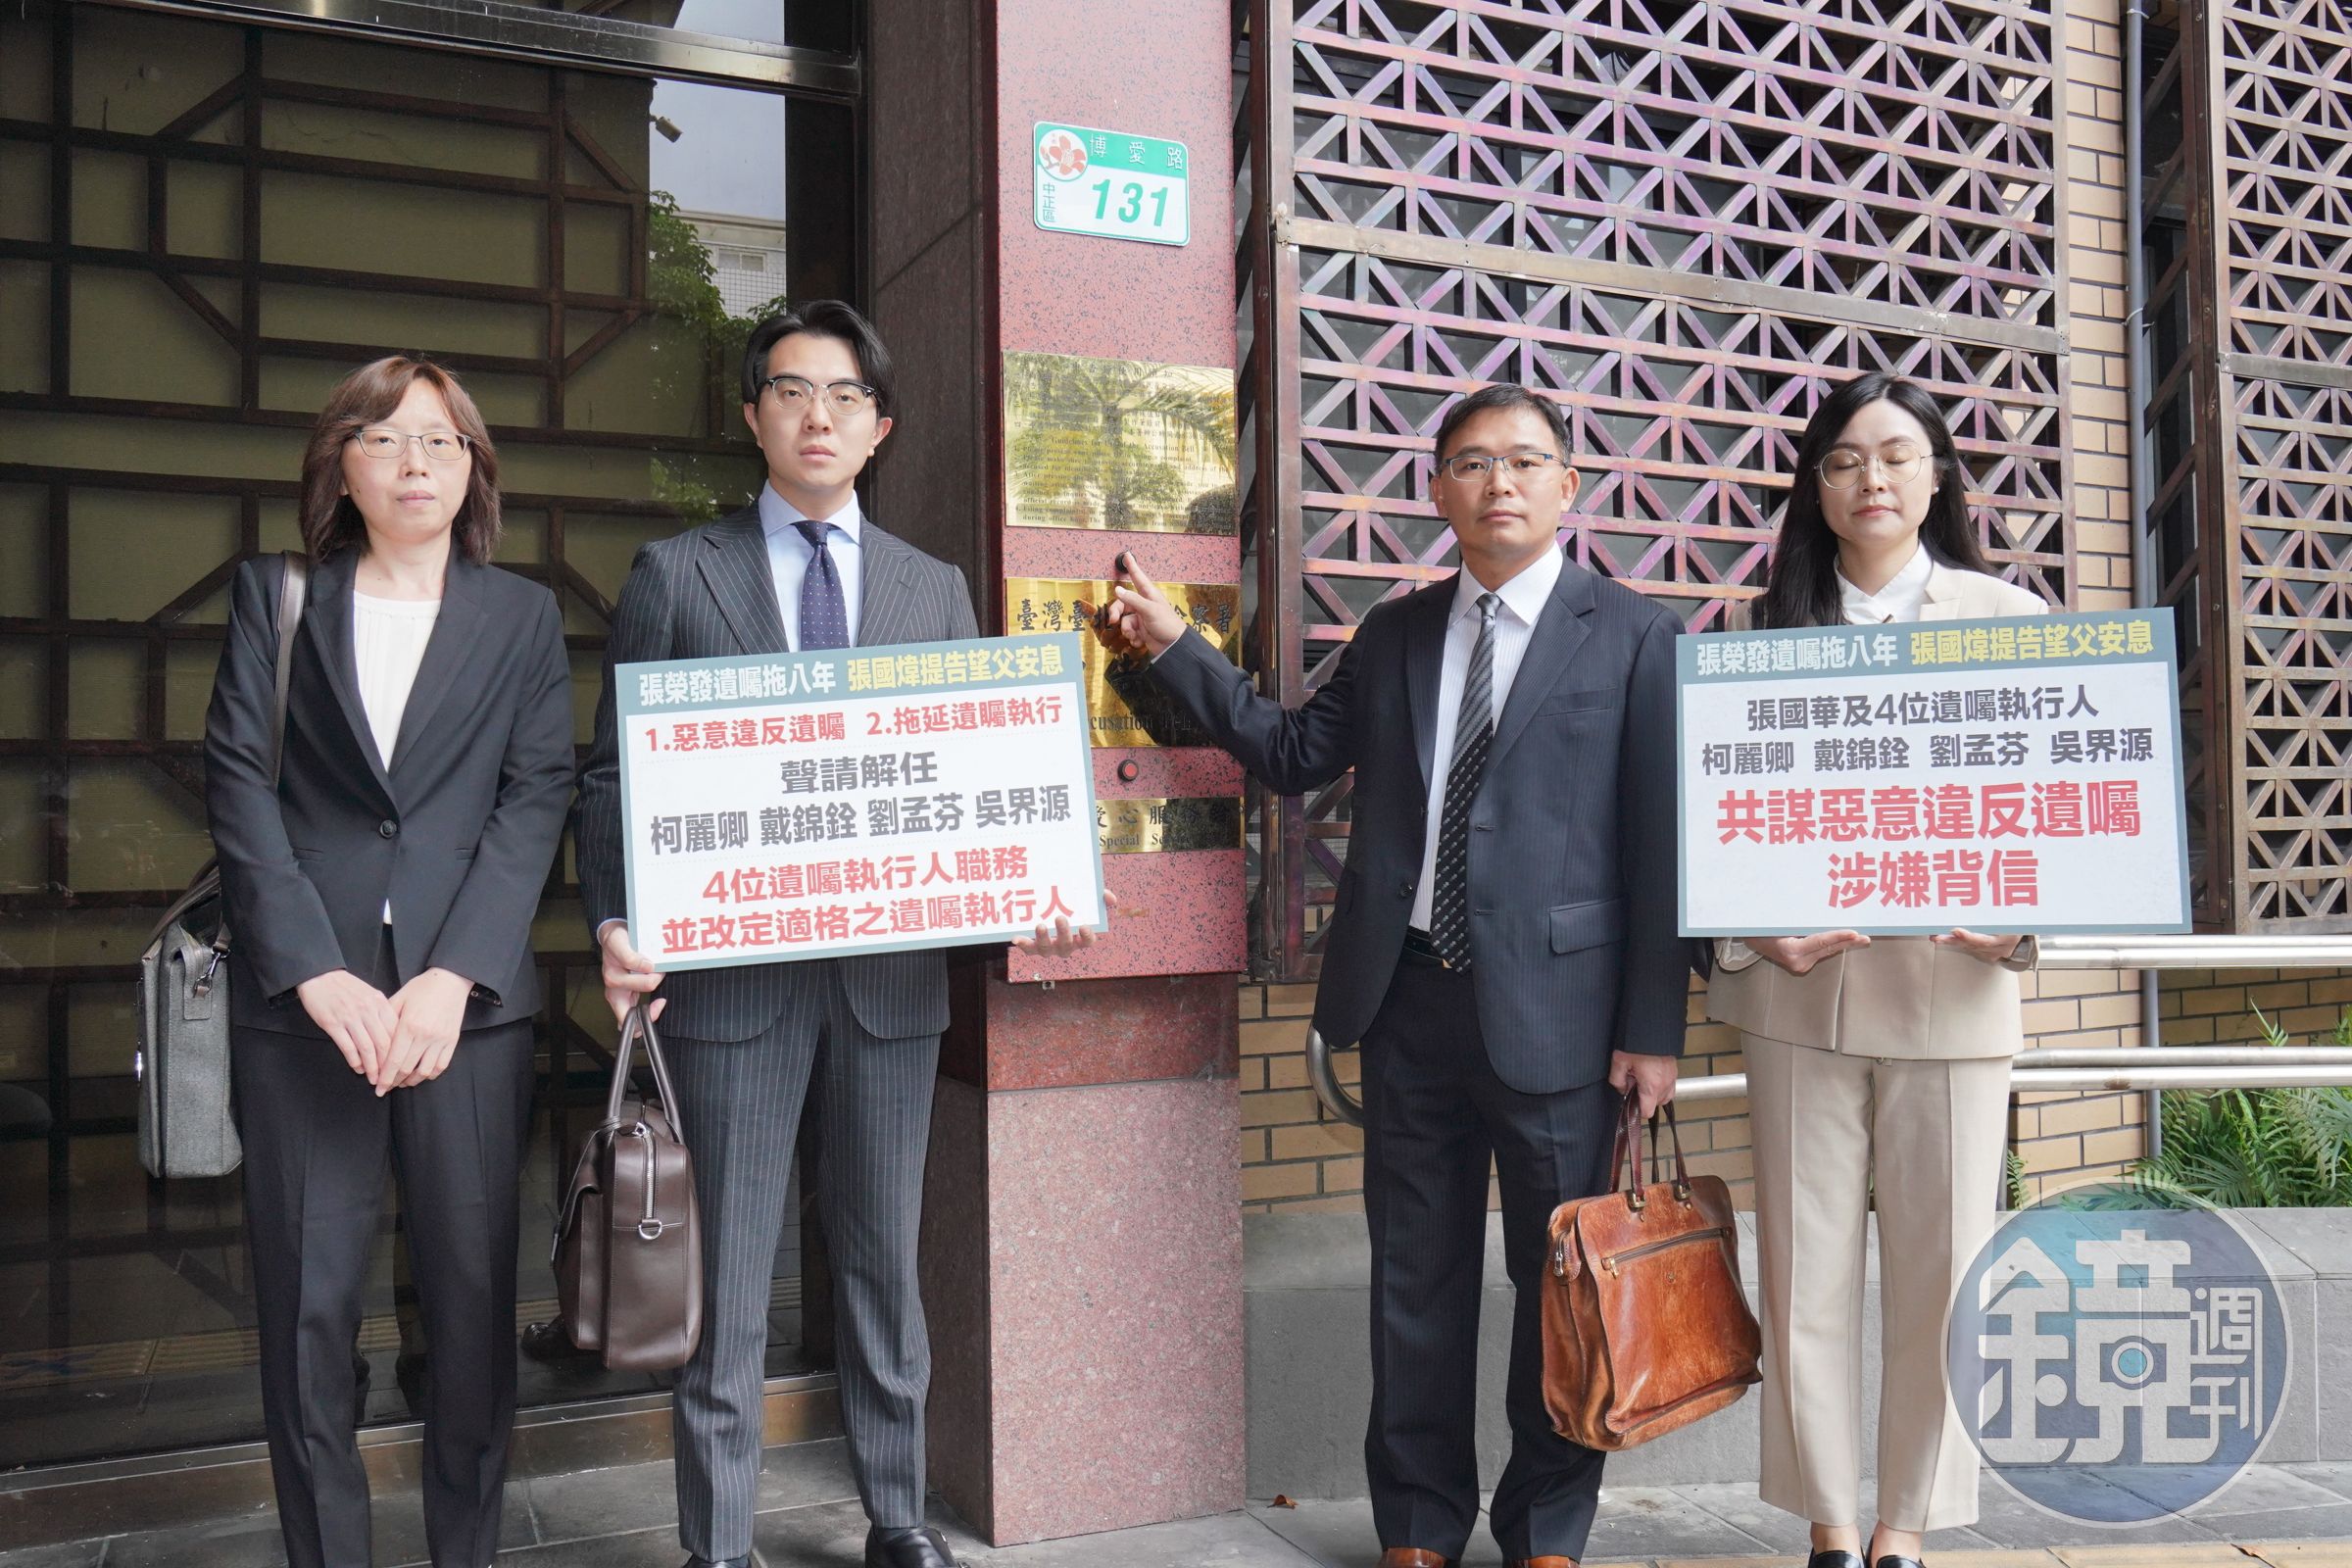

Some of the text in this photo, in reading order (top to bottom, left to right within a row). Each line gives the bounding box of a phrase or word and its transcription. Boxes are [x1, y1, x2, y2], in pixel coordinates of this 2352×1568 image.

[1090, 133, 1183, 171] 博愛路
[1043, 182, 1056, 222] 中正區
[1092, 178, 1168, 227] 131
[1696, 619, 2154, 676] 張榮發遺囑拖八年 張國煒提告望父安息
[639, 644, 1064, 707] 張榮發遺囑拖八年 張國煒提告望父安息
[1746, 683, 2099, 731] 張國華及4位遺囑執行人
[780, 751, 938, 794] 聲請解任
[1701, 727, 2154, 776] 柯麗卿 戴錦銓 劉孟芬 吳界源
[651, 784, 1071, 856] 柯麗卿 戴錦銓 劉孟芬 吳界源
[1717, 780, 2140, 845] 共謀惡意違反遺囑
[1099, 834, 1140, 849] Special
[703, 845, 1028, 904] 4位遺囑執行人職務
[1828, 849, 2038, 908] 涉嫌背信
[662, 885, 1074, 954] 並改定適格之遺囑執行人
